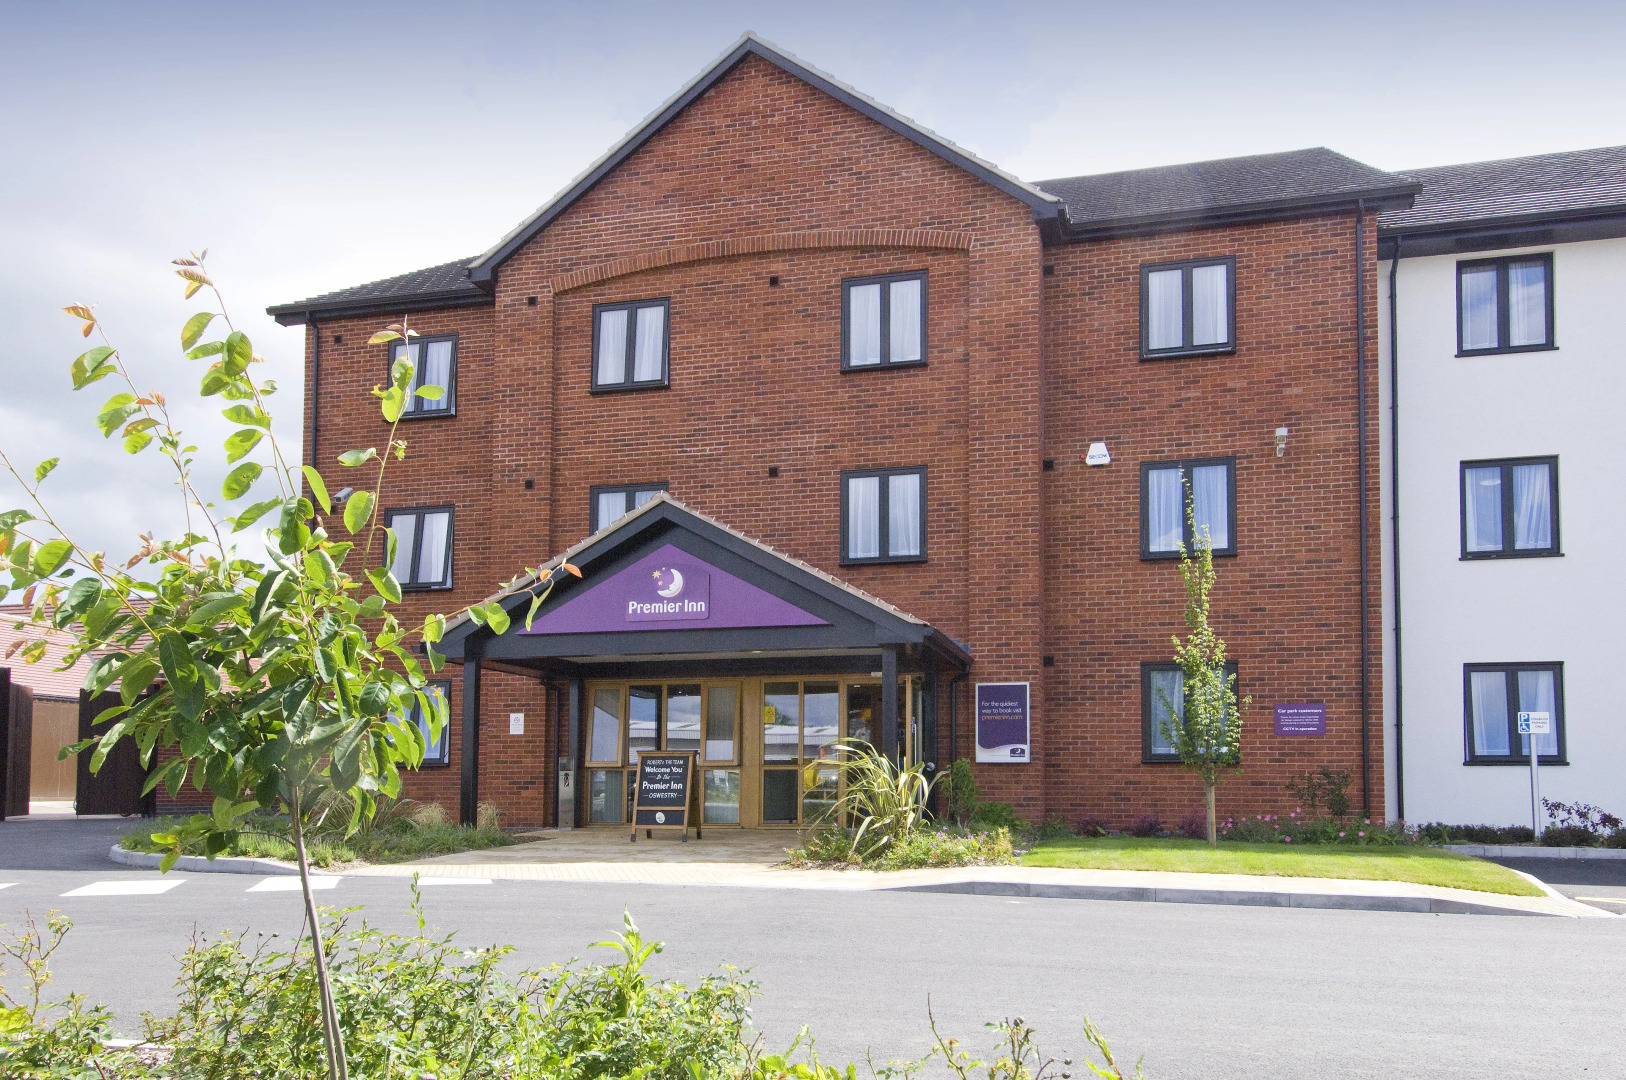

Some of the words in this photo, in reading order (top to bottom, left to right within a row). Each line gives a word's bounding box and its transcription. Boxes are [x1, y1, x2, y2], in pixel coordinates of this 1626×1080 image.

[628, 600, 682, 614] Premier
[684, 600, 705, 612] Inn
[642, 781, 670, 790] Premier
[670, 780, 682, 790] Inn
